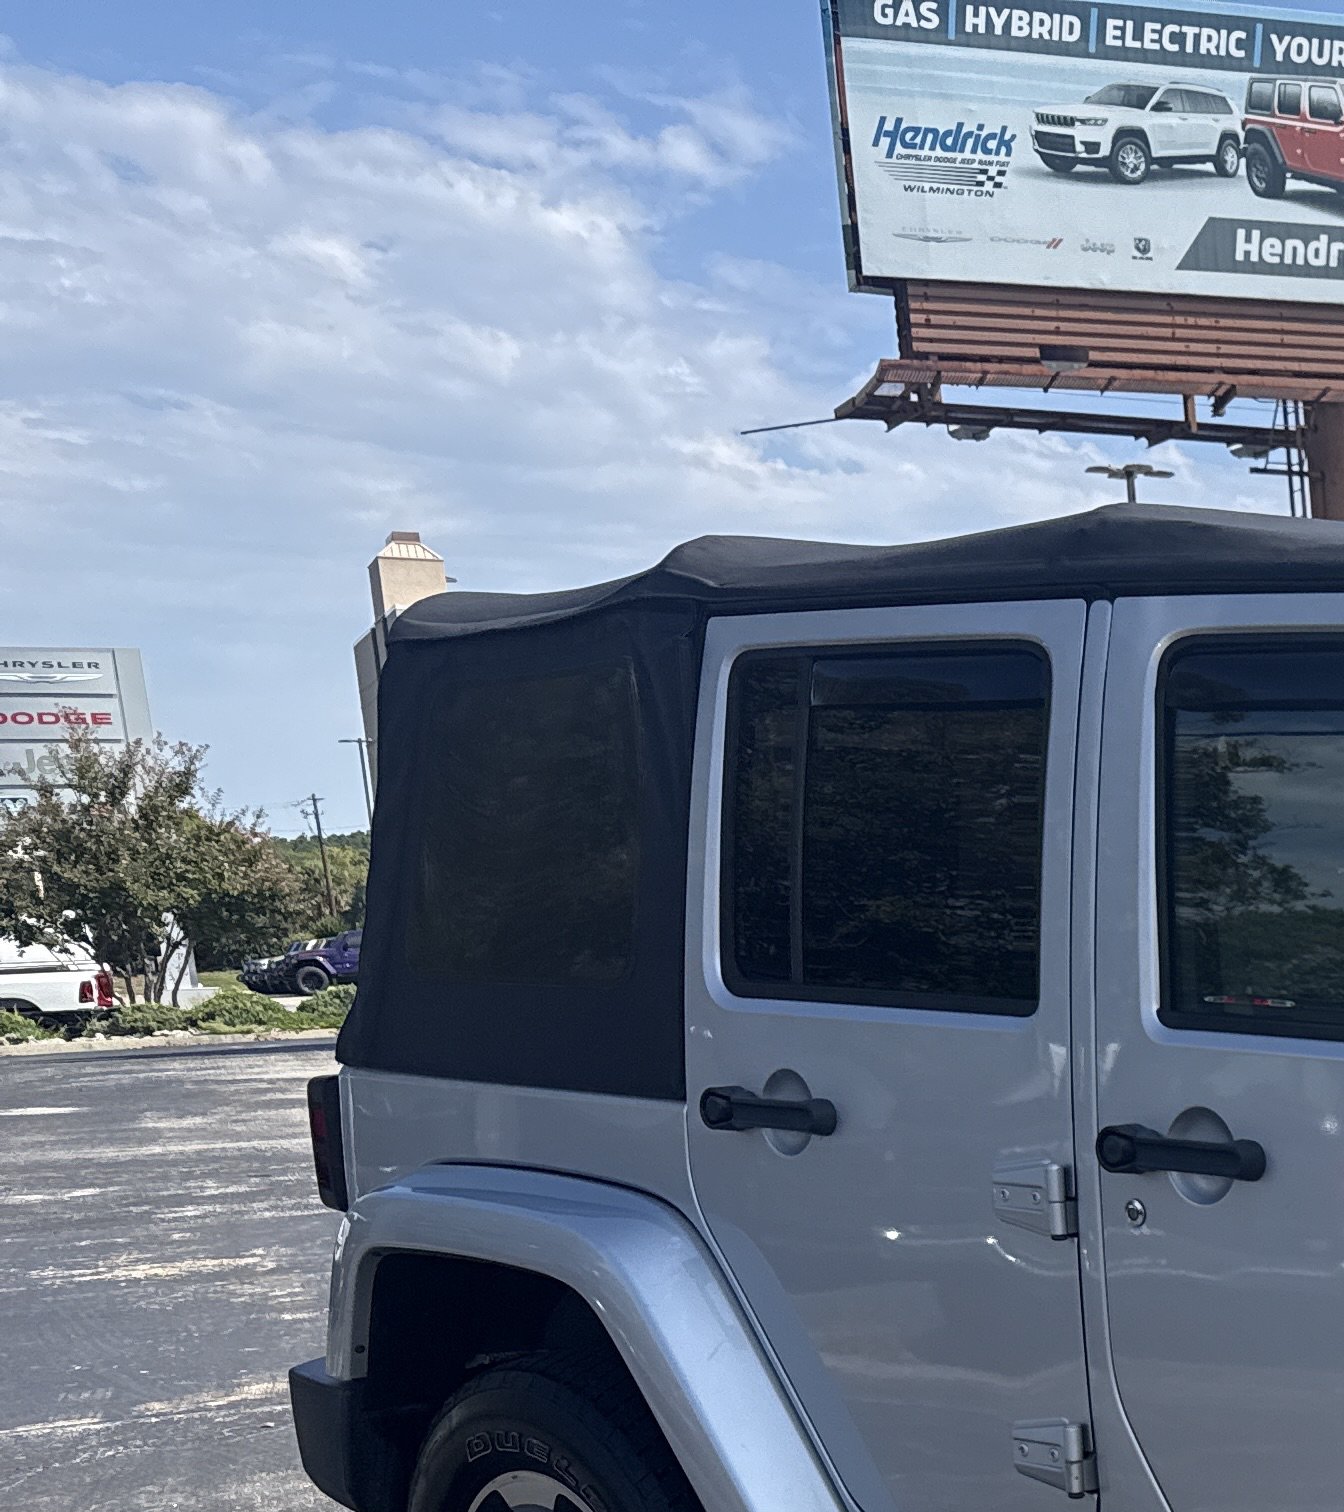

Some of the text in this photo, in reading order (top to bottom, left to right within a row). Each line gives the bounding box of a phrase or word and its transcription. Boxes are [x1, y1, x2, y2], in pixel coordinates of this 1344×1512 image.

[873, 0, 940, 30] GAS
[964, 4, 1082, 43] HYBRID
[1105, 18, 1248, 58] ELECTRIC
[871, 115, 1017, 159] Hendrick
[902, 184, 996, 199] WILMINGTON
